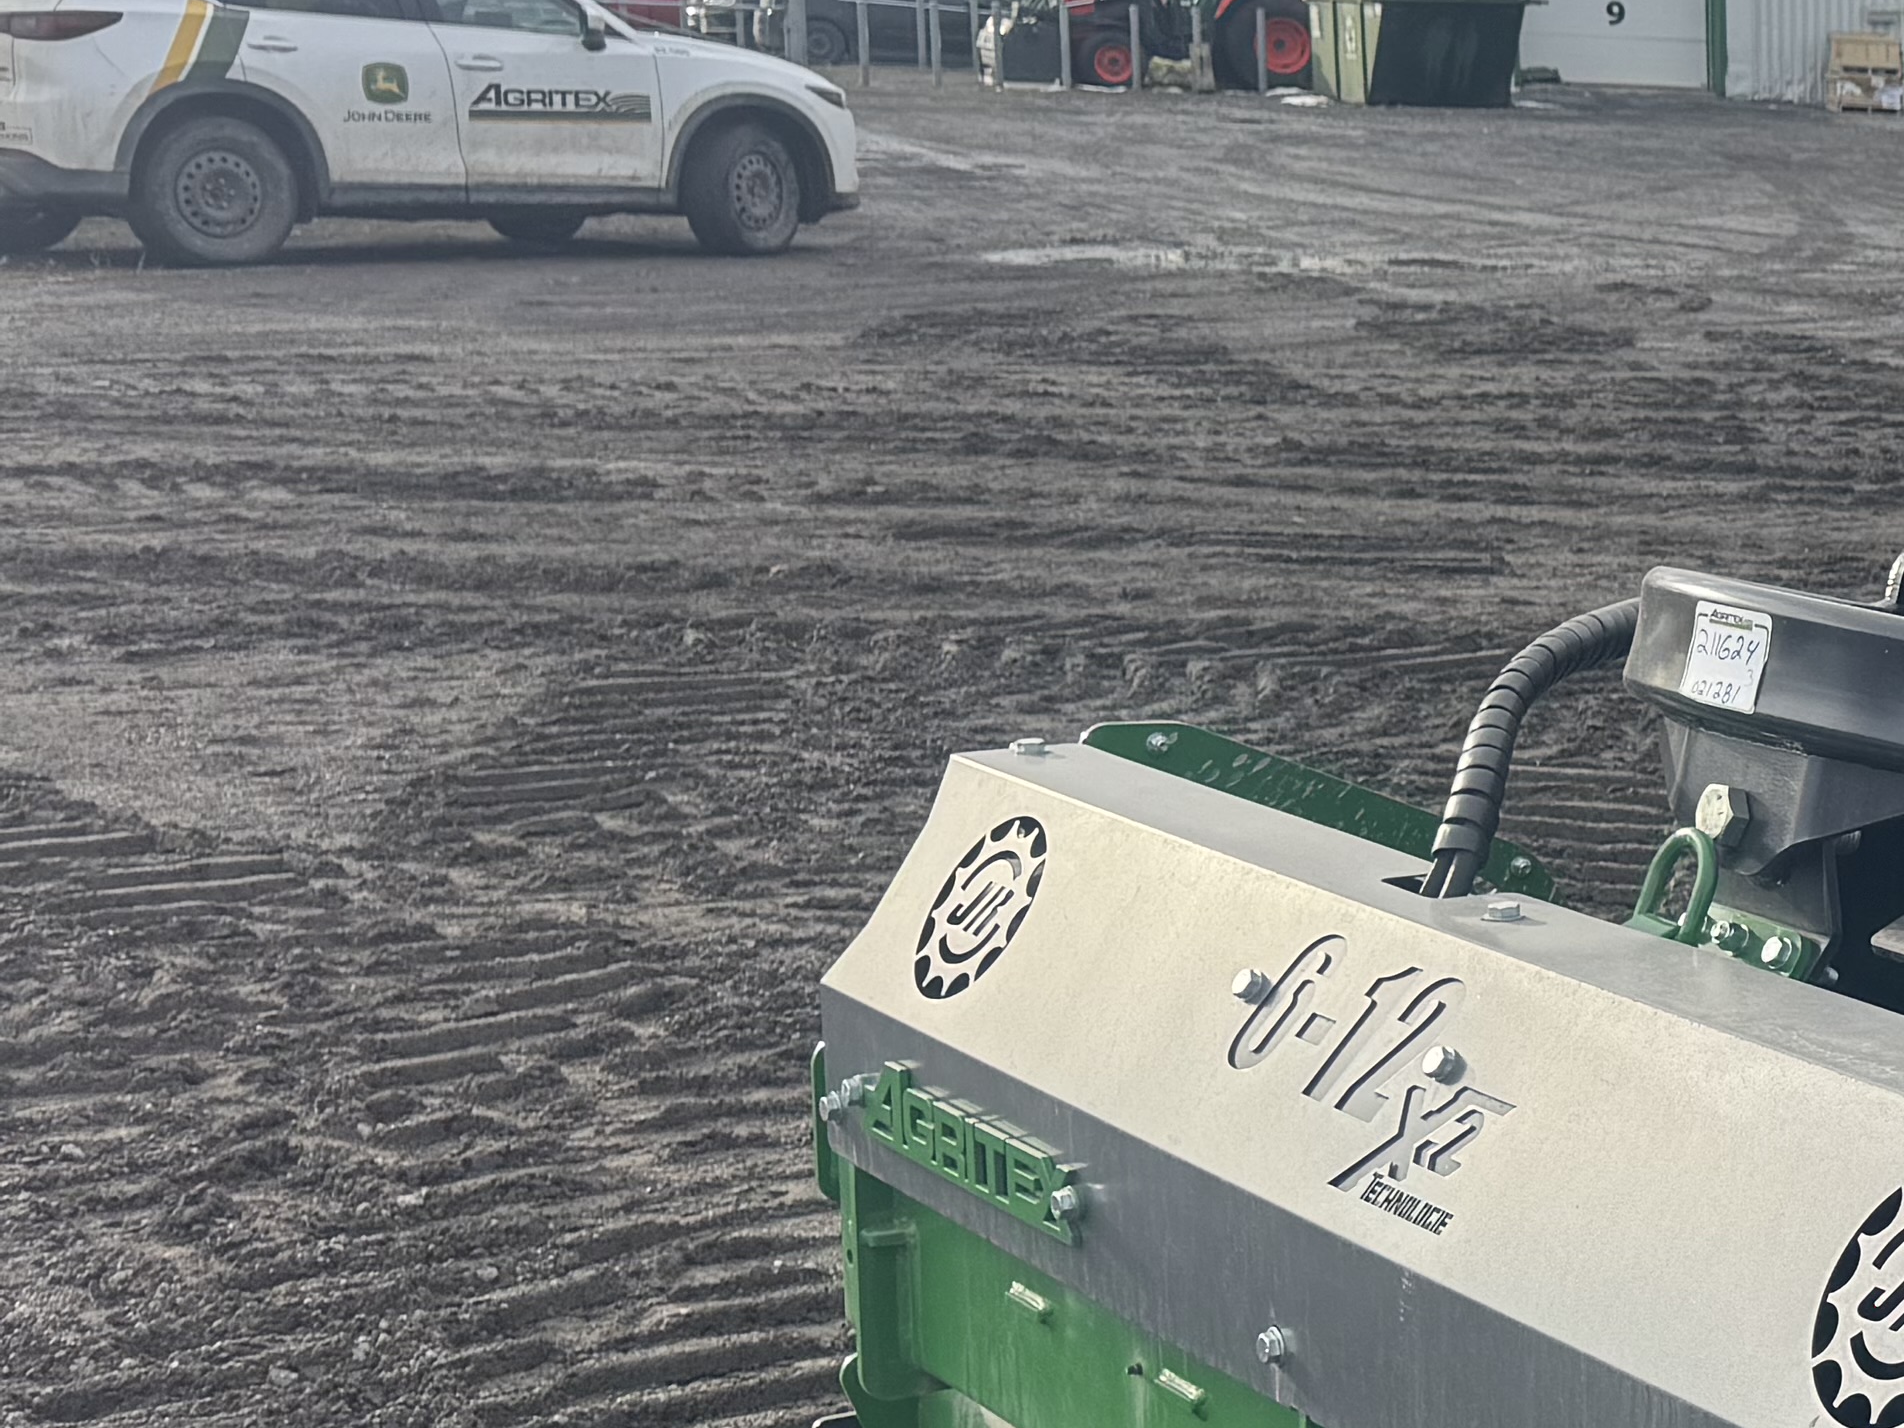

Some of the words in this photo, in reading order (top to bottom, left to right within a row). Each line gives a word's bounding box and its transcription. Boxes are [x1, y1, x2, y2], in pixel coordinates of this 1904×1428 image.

[1606, 0, 1625, 26] 9
[470, 83, 612, 109] AGRITEX
[343, 109, 382, 123] JOHN
[384, 109, 432, 124] DEERE
[1360, 1172, 1455, 1236] TECHNOLOGIE
